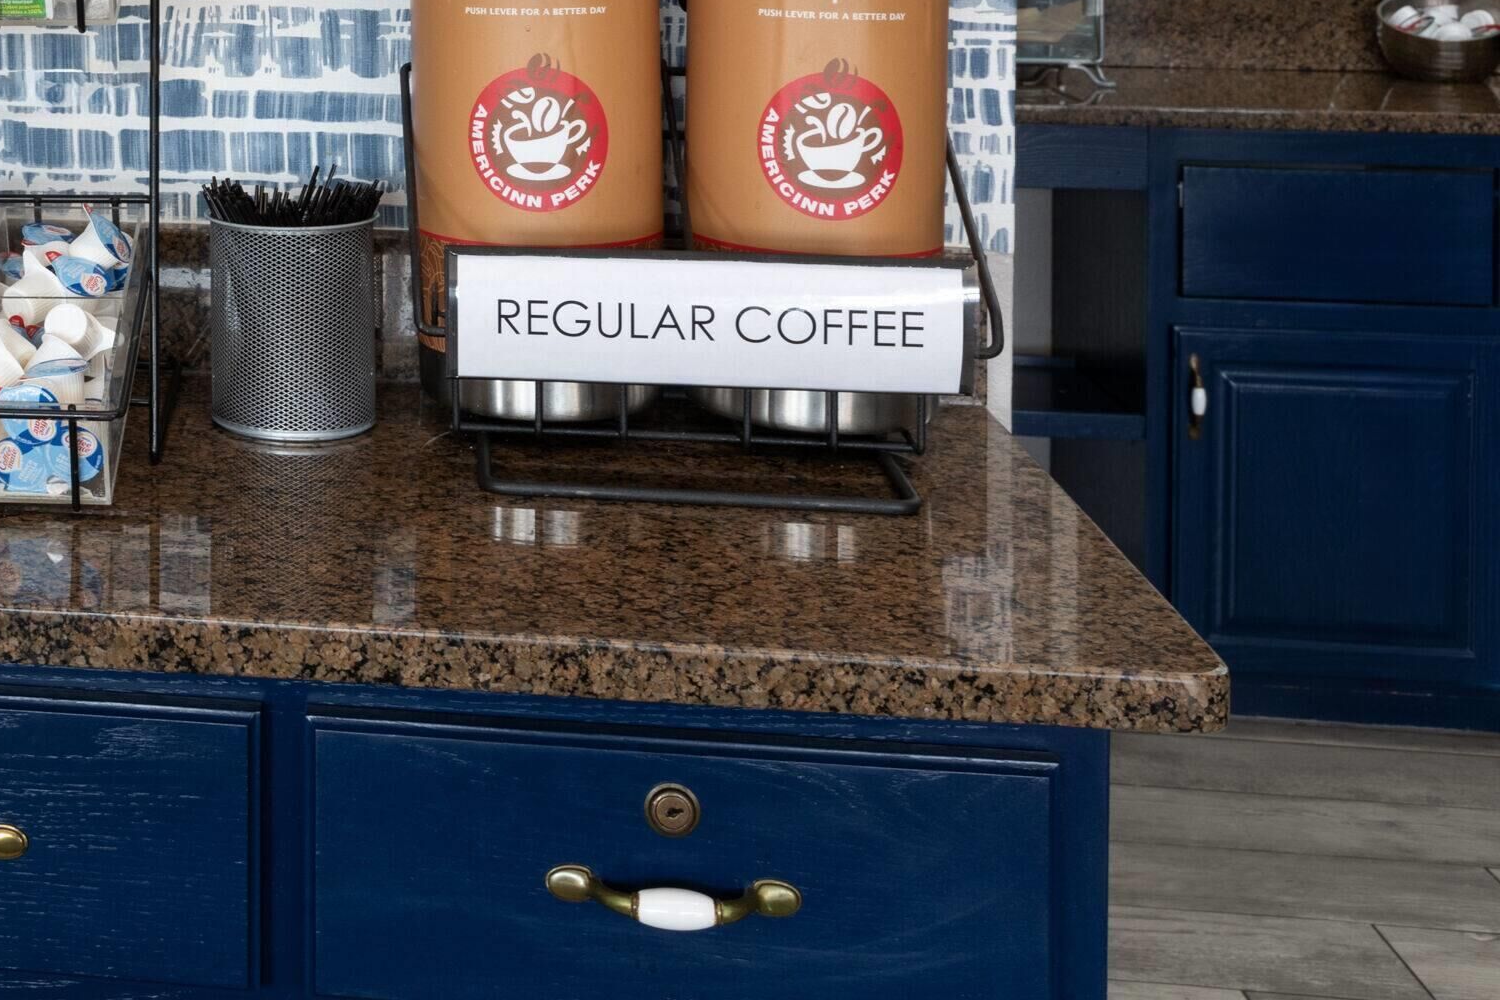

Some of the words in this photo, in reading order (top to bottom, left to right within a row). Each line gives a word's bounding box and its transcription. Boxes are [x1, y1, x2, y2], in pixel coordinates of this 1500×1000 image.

[465, 7, 487, 15] PUSH
[490, 8, 517, 16] LEVER
[521, 8, 539, 16] FOR
[553, 7, 587, 15] BETTER
[590, 6, 606, 14] DAY
[758, 8, 782, 17] PUSH
[785, 10, 816, 19] LEVER
[819, 11, 839, 20] FOR
[842, 12, 849, 20] A
[852, 12, 887, 21] BETTER
[889, 13, 906, 21] DAY
[472, 103, 542, 208] AMERICINN
[551, 160, 601, 206] PERK
[761, 107, 835, 216] AMERICINN
[843, 169, 895, 215] PERK
[498, 299, 717, 342] REGULAR
[736, 308, 924, 348] COFFEE
